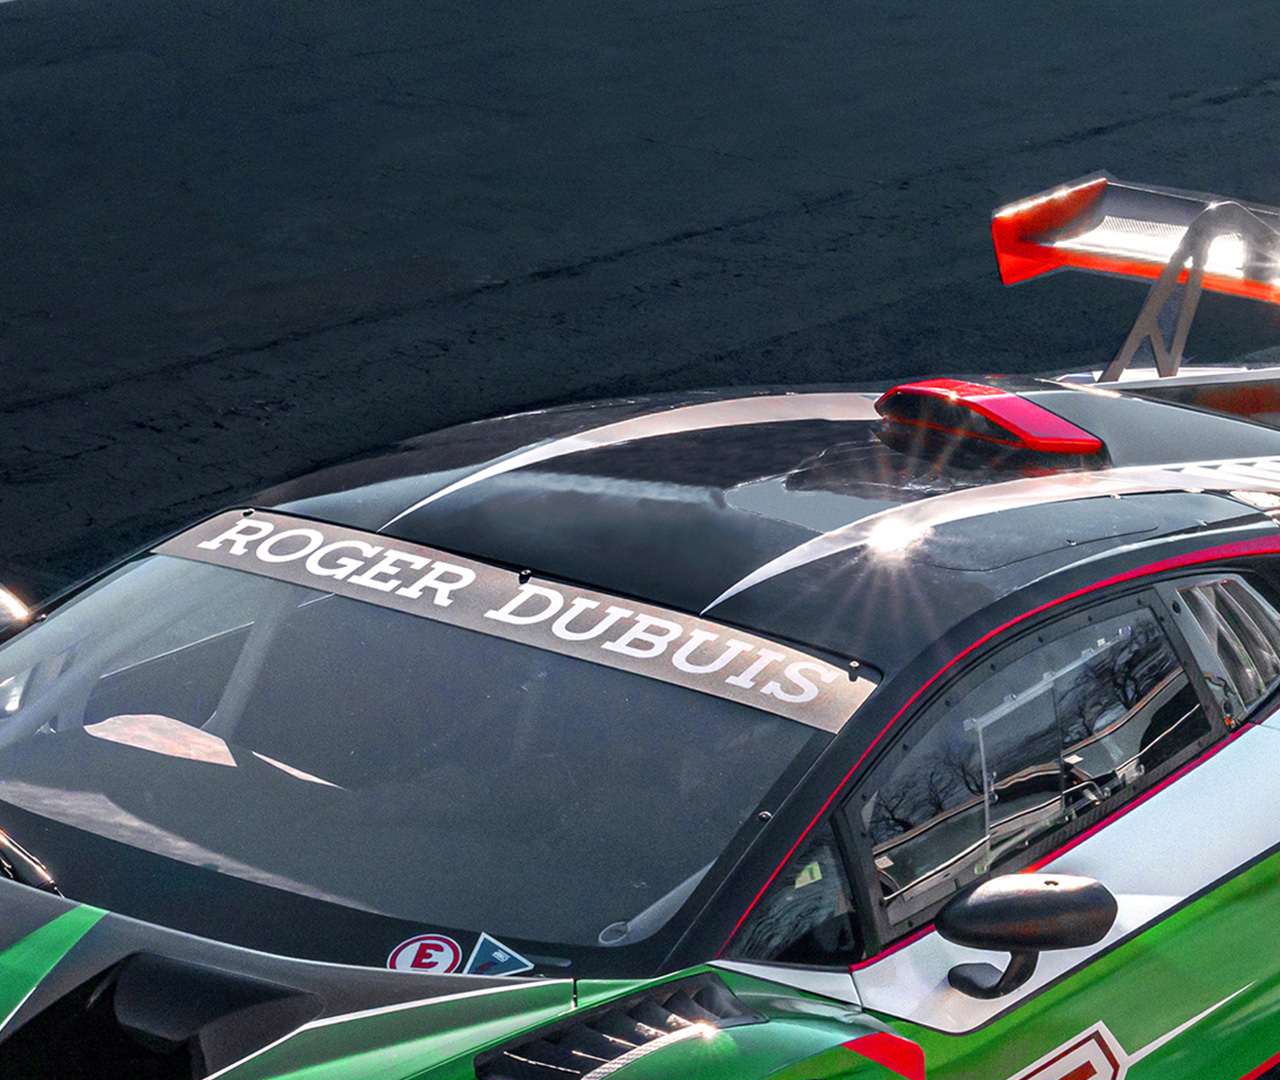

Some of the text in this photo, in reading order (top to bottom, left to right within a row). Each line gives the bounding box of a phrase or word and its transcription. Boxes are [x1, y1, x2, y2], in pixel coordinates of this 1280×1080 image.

[197, 518, 839, 705] ROGER DUBUIS
[410, 943, 445, 969] E
